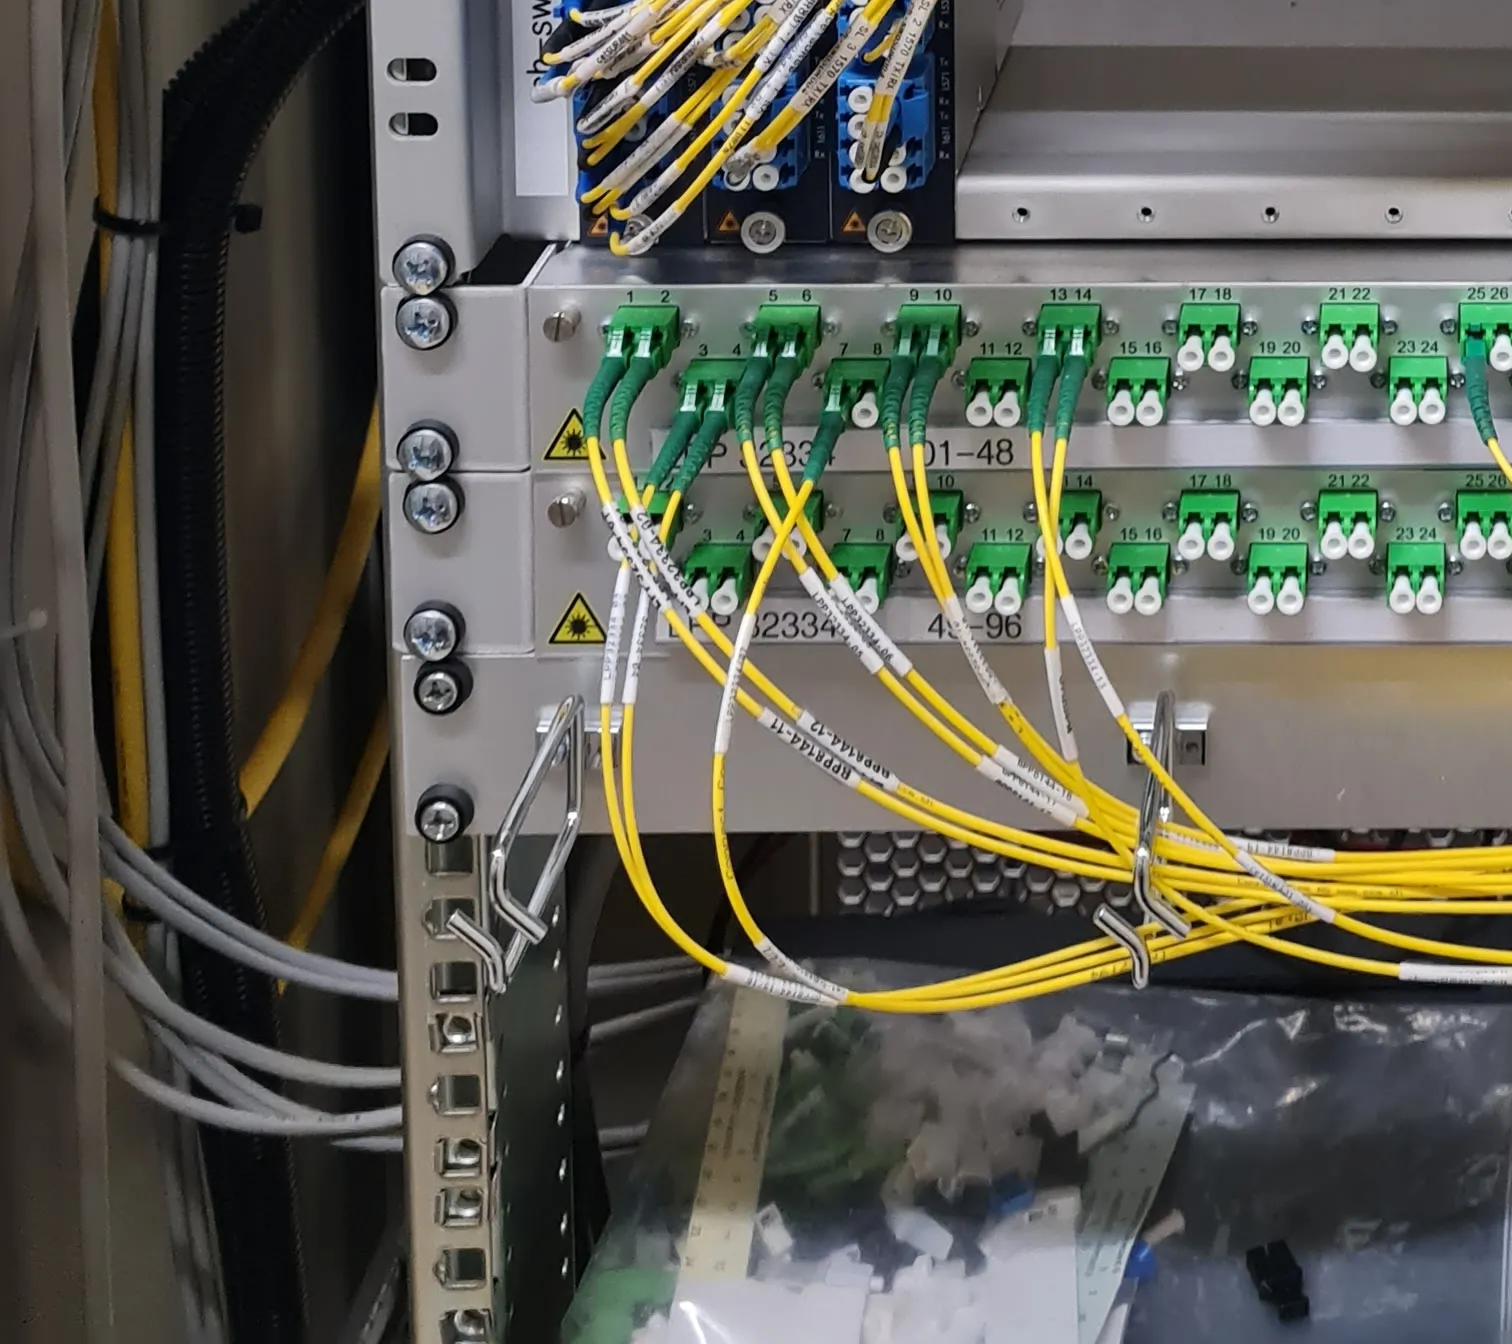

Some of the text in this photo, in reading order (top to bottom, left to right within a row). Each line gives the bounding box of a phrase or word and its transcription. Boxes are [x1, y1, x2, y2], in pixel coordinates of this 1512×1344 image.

[661, 290, 669, 303] 2
[769, 289, 811, 302] 5 6
[910, 289, 952, 301] 9 10
[1190, 288, 1231, 300] 17 18
[1329, 288, 1370, 300] 21 22
[1468, 287, 1508, 300] 25 26
[767, 716, 854, 782] BPP8144-11
[807, 717, 893, 784] BPP8144-12
